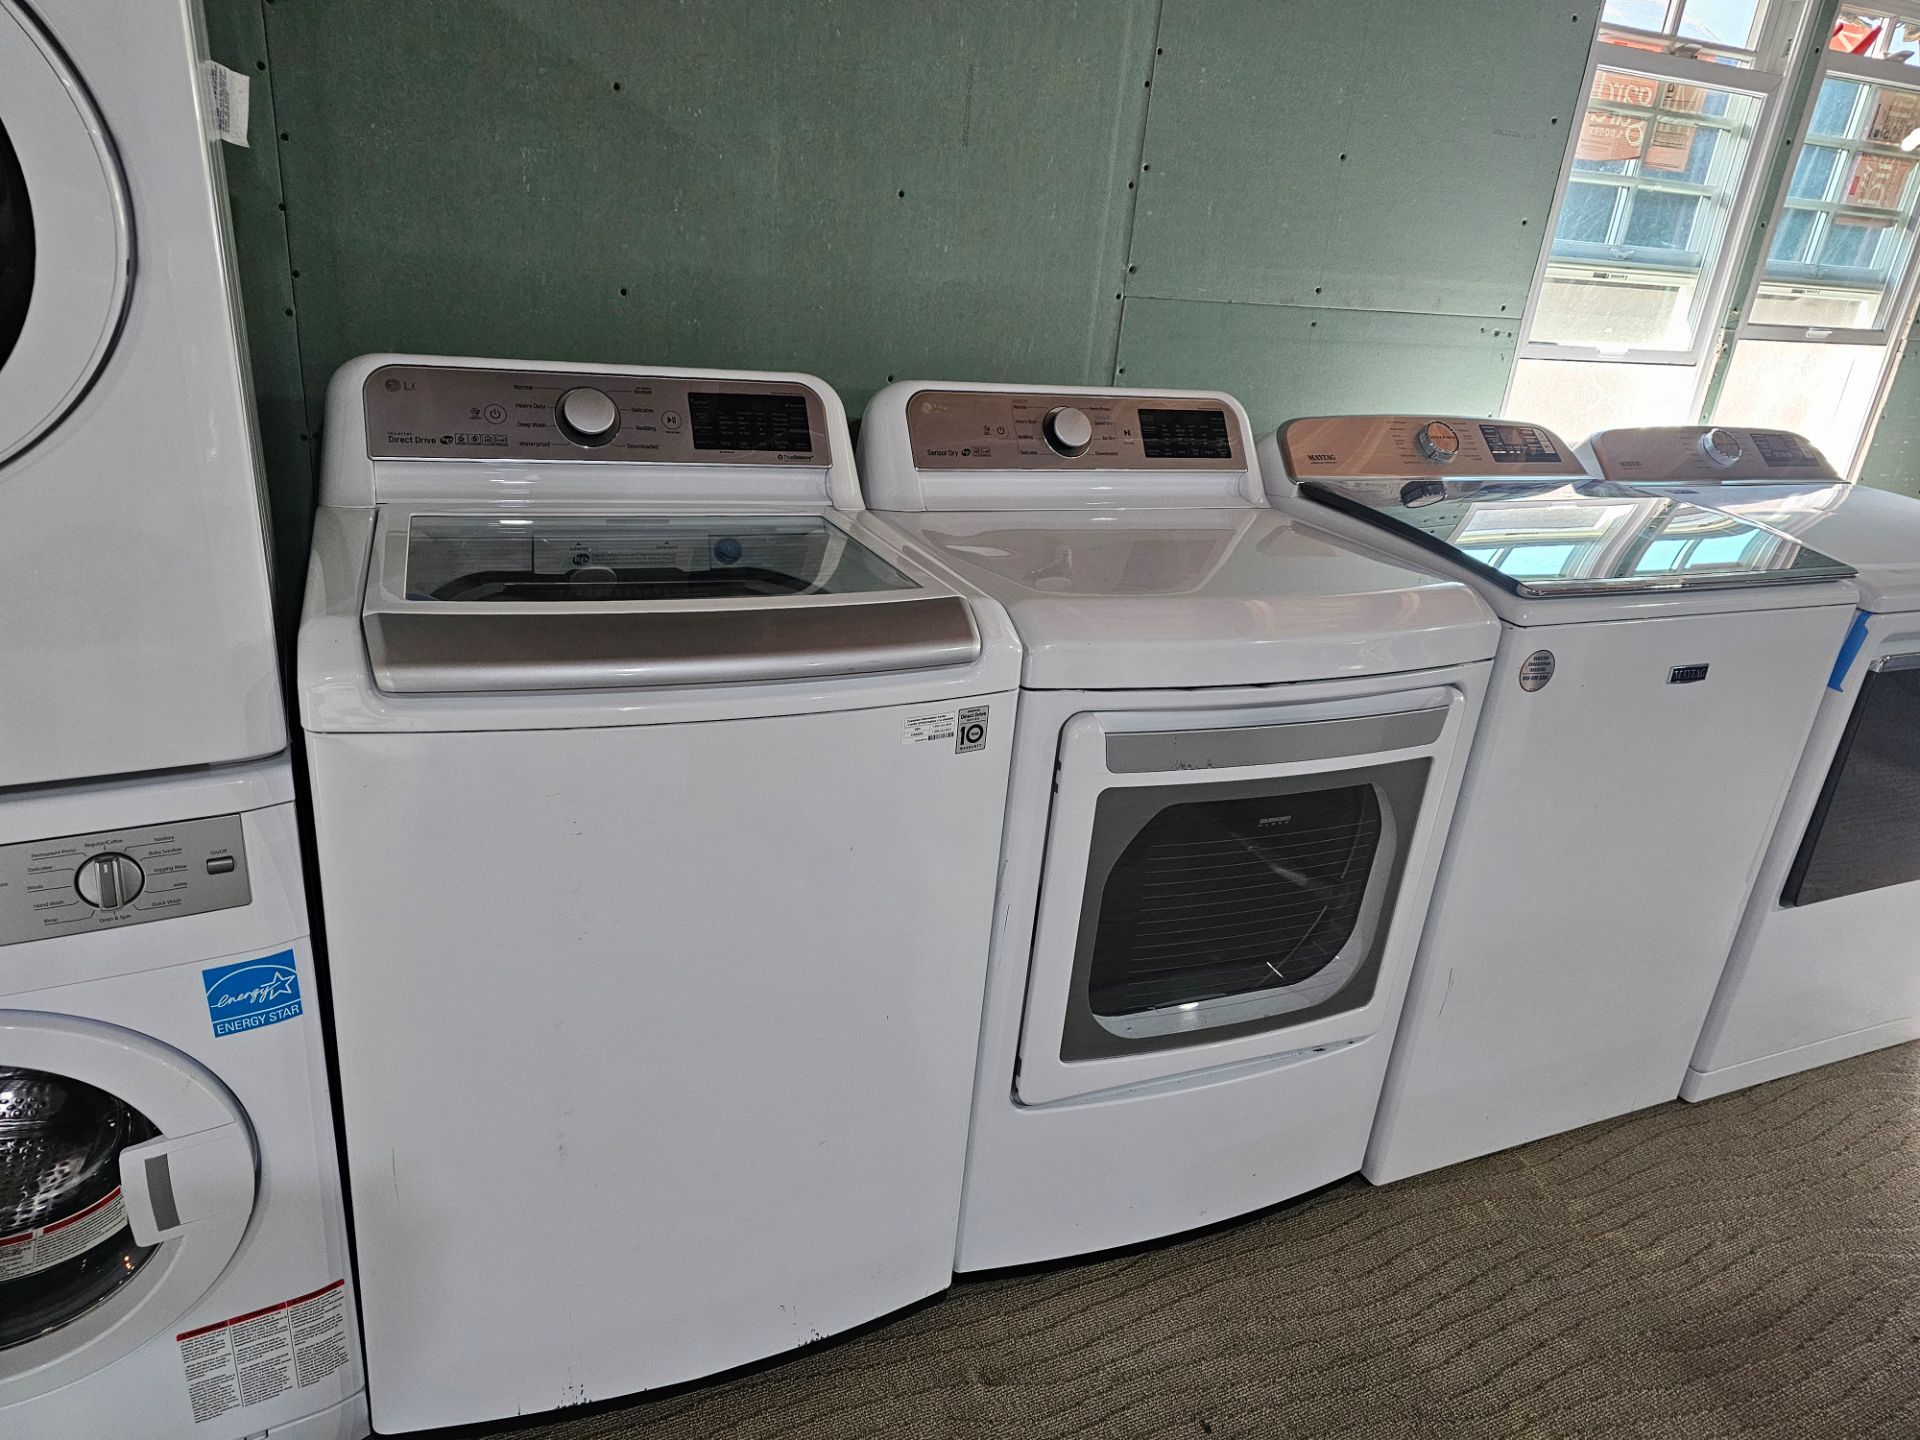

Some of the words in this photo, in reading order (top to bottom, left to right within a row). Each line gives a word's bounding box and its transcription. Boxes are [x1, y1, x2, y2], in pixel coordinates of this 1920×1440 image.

[388, 436, 413, 444] Direct
[948, 449, 959, 458] Dry
[1673, 668, 1707, 680] MAYTAG
[960, 724, 984, 745] 10
[209, 848, 228, 856] On/Off
[210, 985, 274, 1008] energy
[216, 1014, 266, 1035] ENERGY
[268, 1004, 300, 1023] STAR
